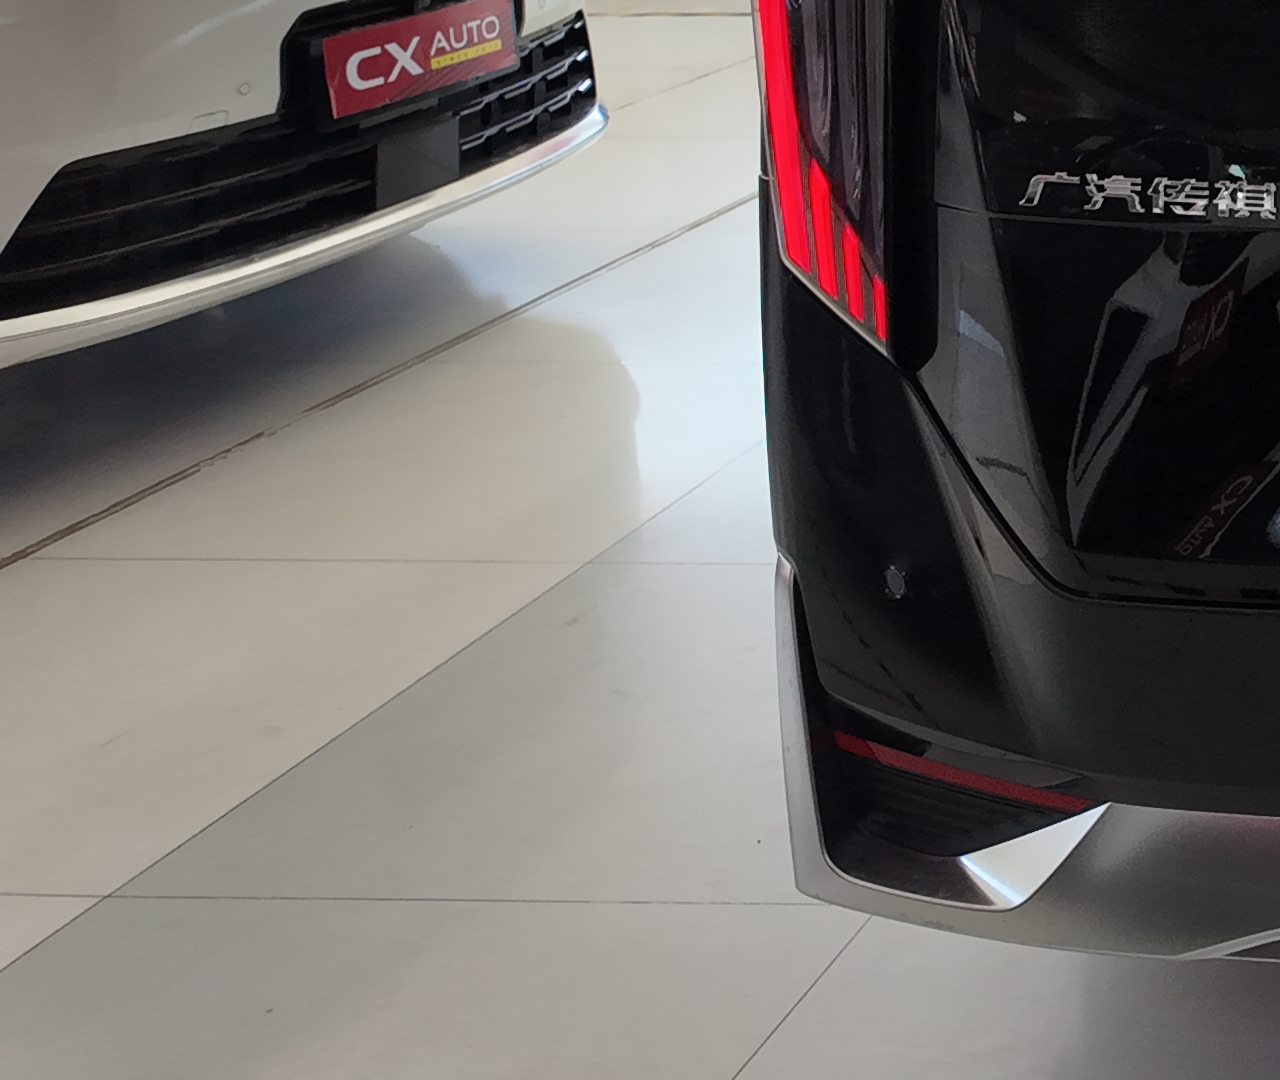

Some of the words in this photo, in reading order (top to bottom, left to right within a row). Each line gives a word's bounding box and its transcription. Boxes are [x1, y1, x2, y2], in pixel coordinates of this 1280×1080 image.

[345, 35, 425, 91] CX
[430, 15, 501, 56] AUTO
[1018, 172, 1278, 220] 广汽传祺
